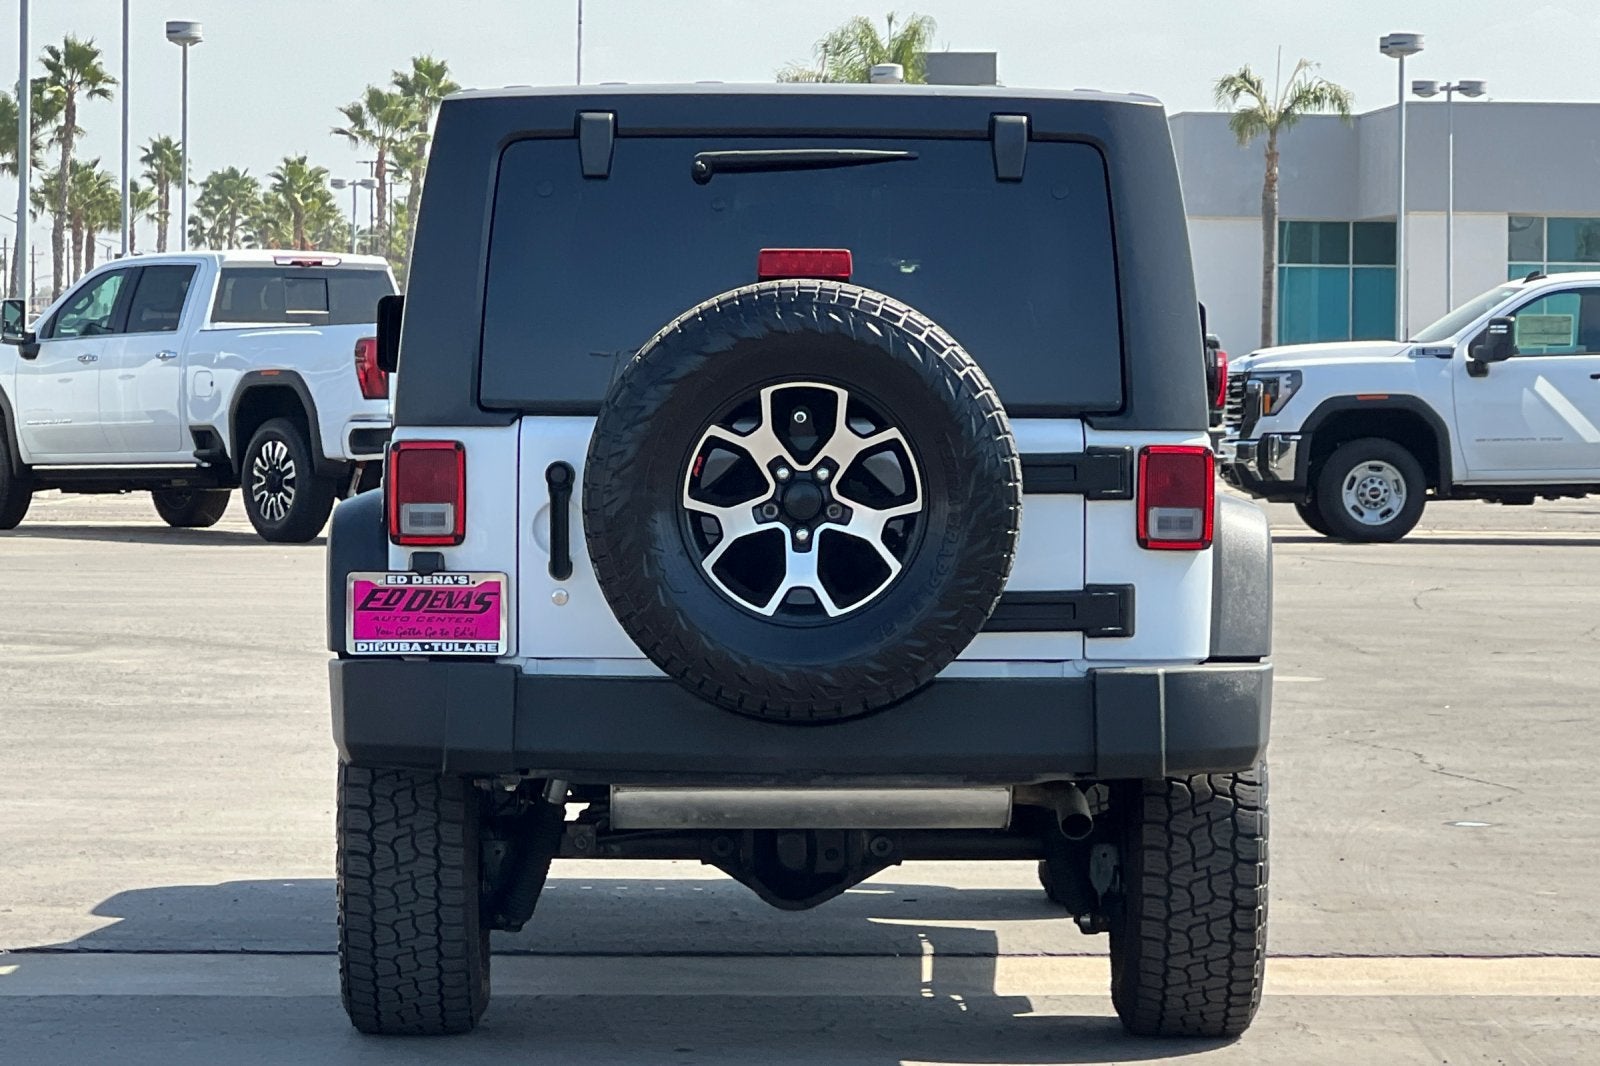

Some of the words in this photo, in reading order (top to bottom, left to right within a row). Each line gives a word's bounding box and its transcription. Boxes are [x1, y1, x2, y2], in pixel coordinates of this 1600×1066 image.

[386, 575, 408, 585] ED
[411, 575, 468, 585] DENA'S
[356, 588, 409, 612] ED
[402, 588, 499, 614] DENA'S
[371, 615, 411, 623] AUTO
[415, 616, 475, 624] CENTER
[375, 626, 393, 636] You
[395, 626, 422, 638] Gotta
[424, 626, 437, 638] Go
[440, 627, 450, 636] to
[356, 642, 422, 652] DINUBA
[431, 642, 498, 652] TULARE
